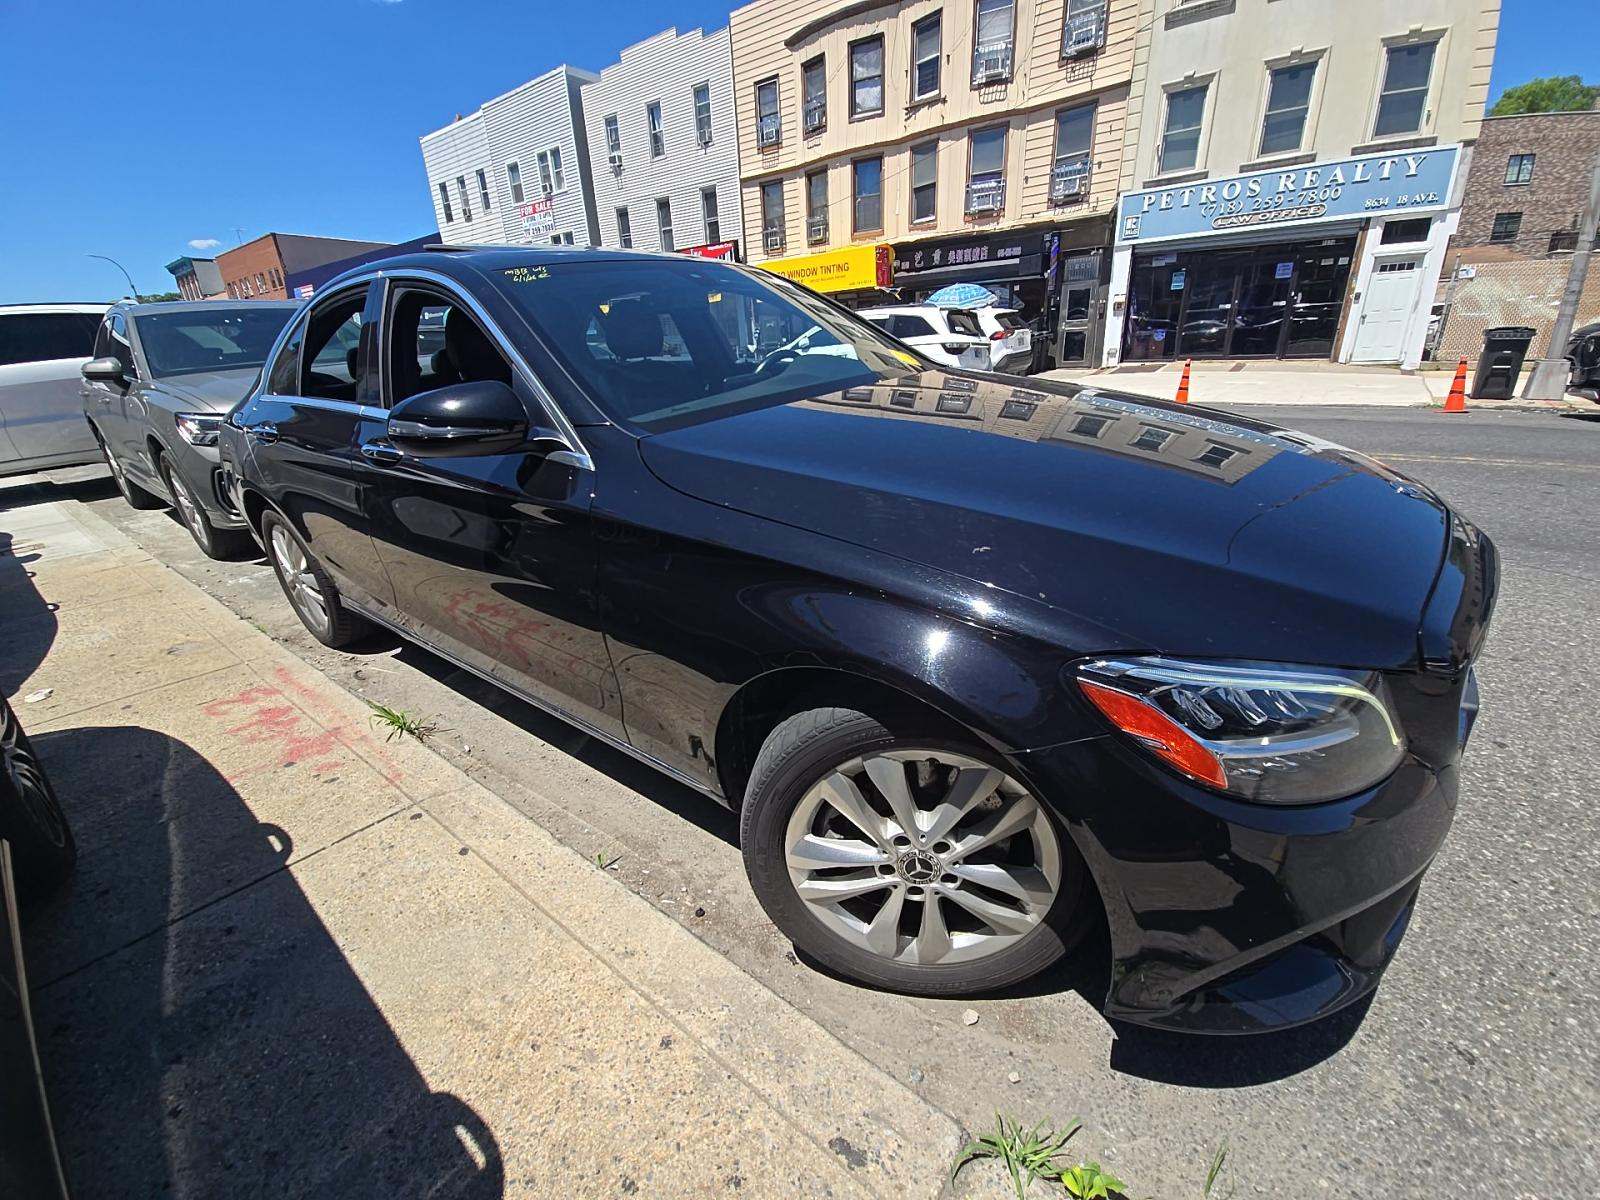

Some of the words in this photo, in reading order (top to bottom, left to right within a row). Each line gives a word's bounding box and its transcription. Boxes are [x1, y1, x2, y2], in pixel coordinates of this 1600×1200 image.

[1142, 178, 1261, 213] PETROS
[1276, 154, 1427, 194] REALTY
[521, 205, 533, 217] FOR
[535, 200, 551, 213] SALE
[1202, 201, 1243, 217] (718)
[1364, 196, 1389, 210] 8634
[1396, 194, 1408, 207] 18
[1411, 192, 1438, 204] AVE.
[1216, 215, 1252, 227] LAW
[1260, 206, 1321, 221] OFFICE
[788, 267, 818, 279] WINDOW
[820, 262, 850, 275] TINTING
